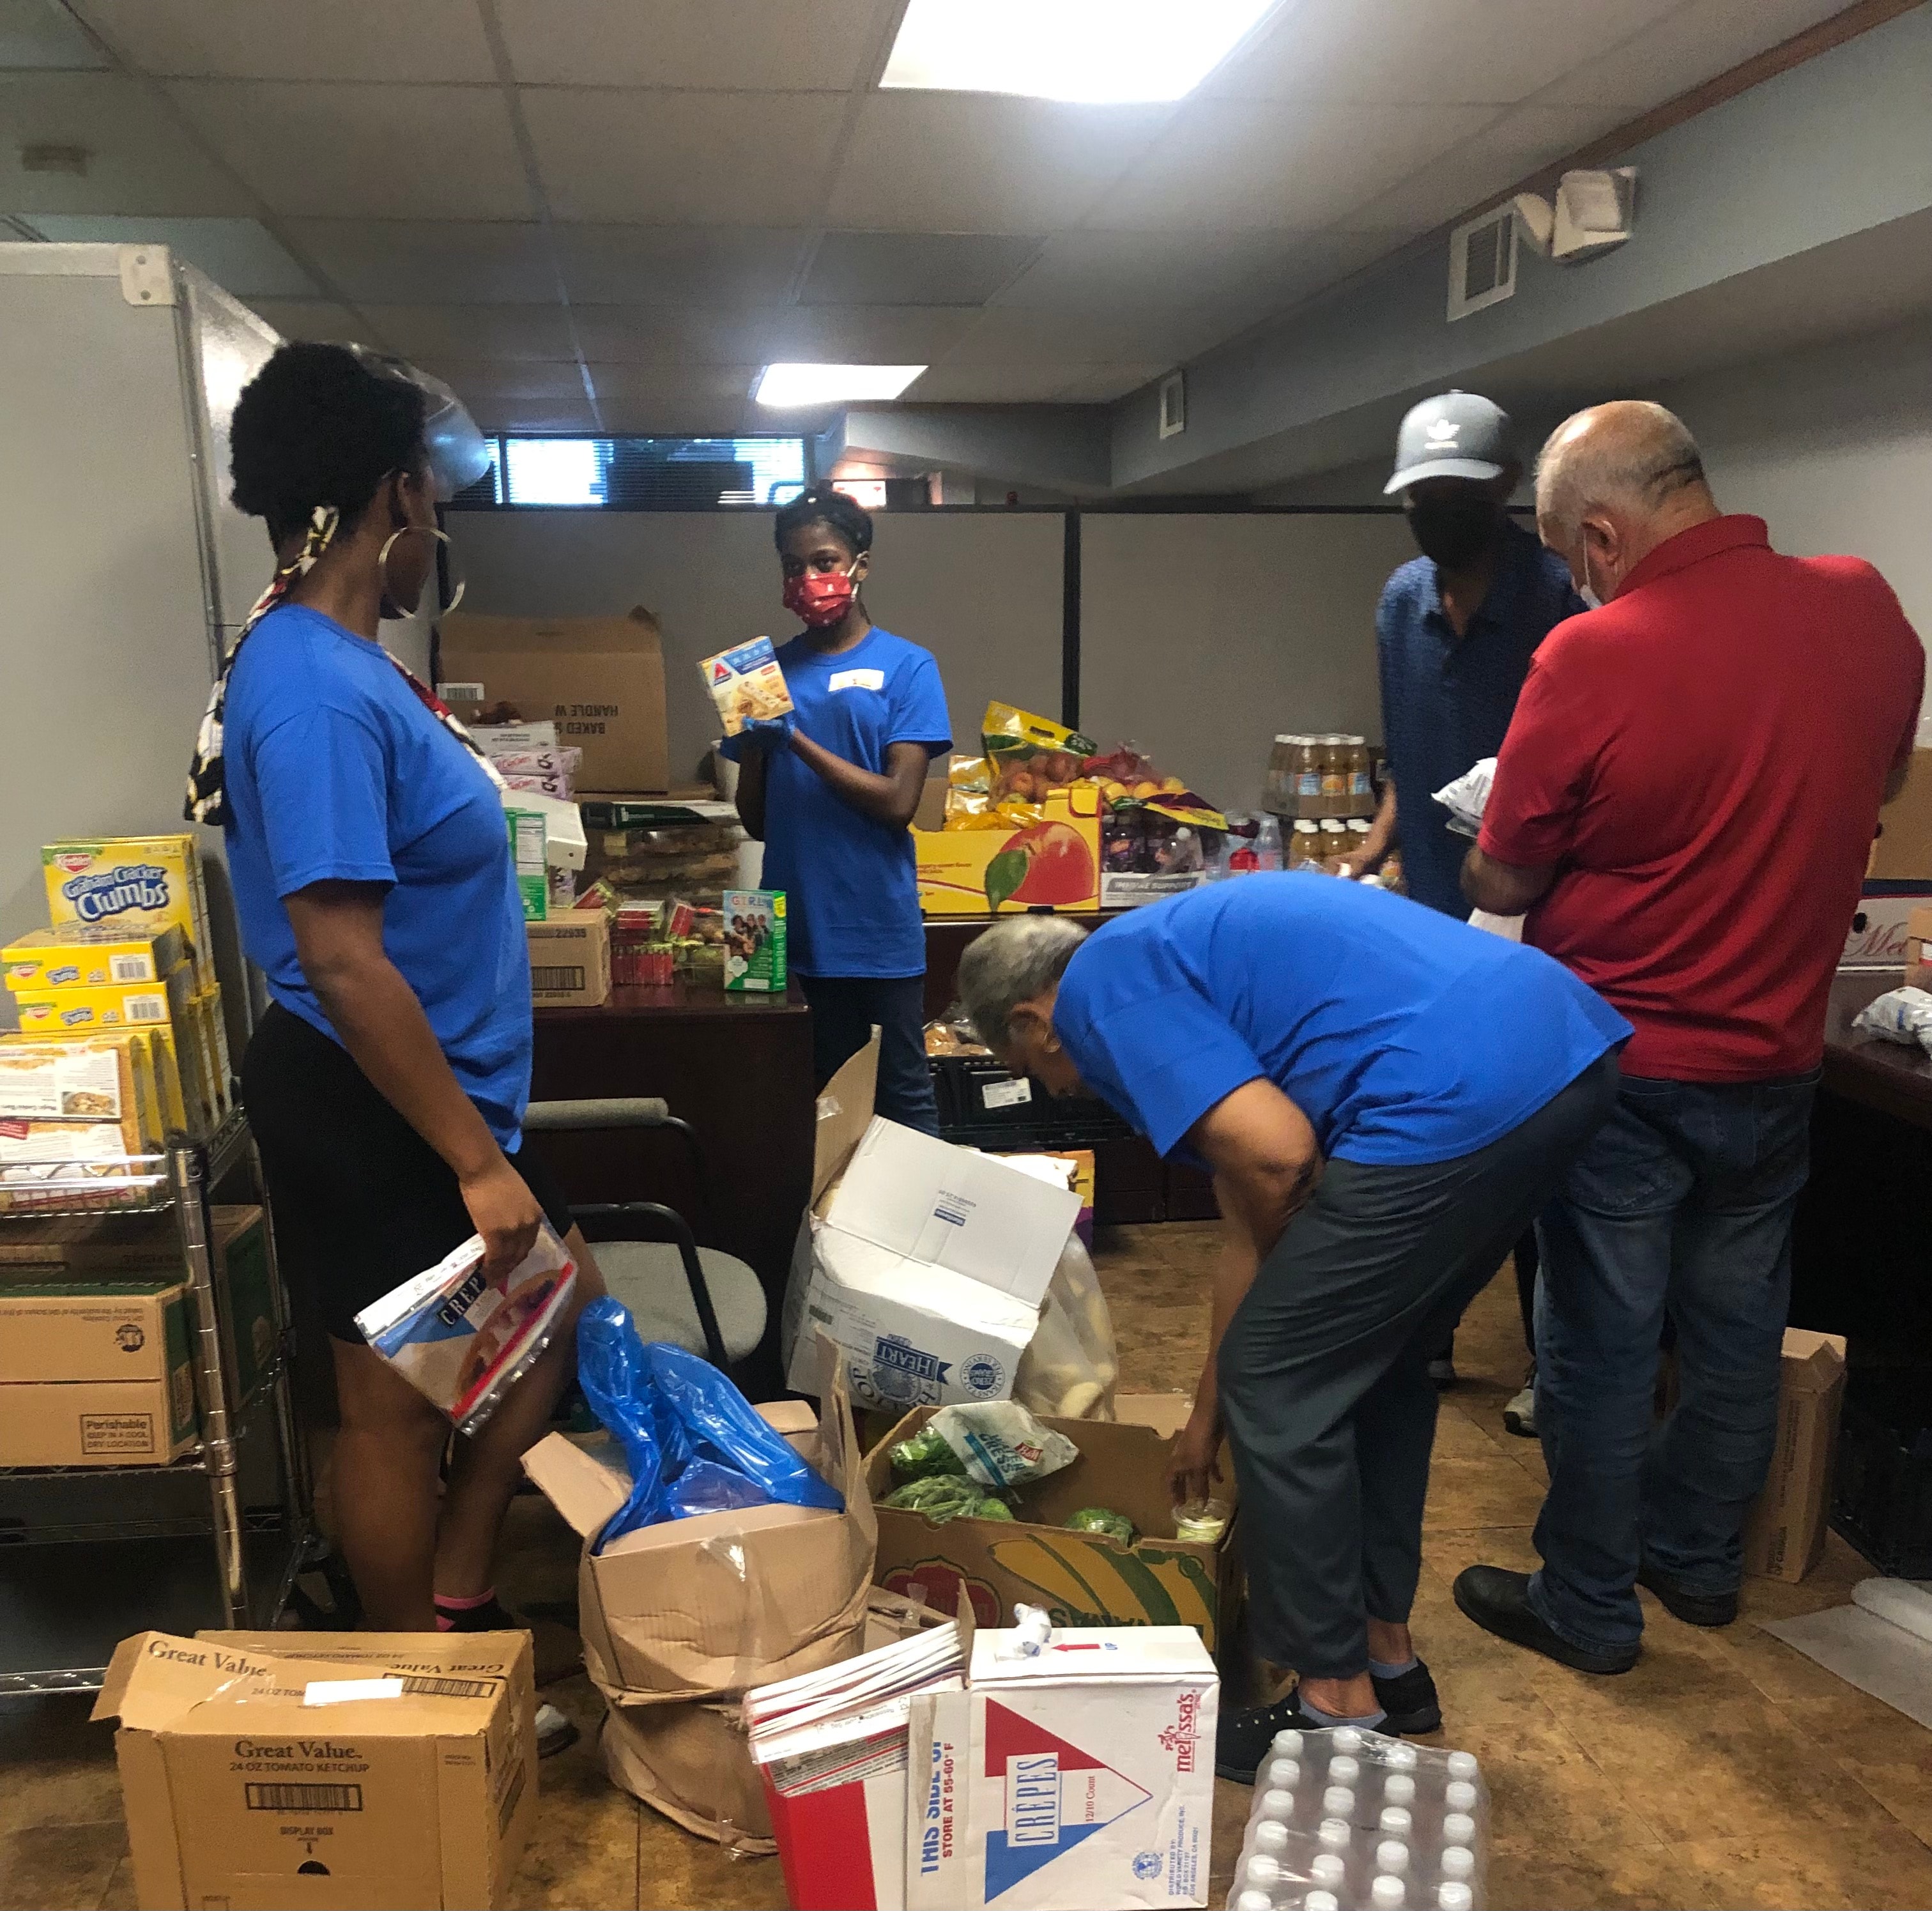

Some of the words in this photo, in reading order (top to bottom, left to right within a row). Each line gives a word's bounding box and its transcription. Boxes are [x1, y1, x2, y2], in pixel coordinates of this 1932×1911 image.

[567, 722, 606, 734] BAKED
[76, 880, 169, 920] Crumbs
[86, 1419, 146, 1429] Perishable
[147, 1640, 207, 1666] Great
[1104, 1642, 1118, 1650] UP
[448, 1664, 505, 1673] Great
[281, 1688, 306, 1697] TOM
[234, 1740, 294, 1758] Great
[944, 1742, 954, 1751] F
[229, 1762, 243, 1772] 24
[245, 1762, 263, 1772] OZ
[265, 1762, 314, 1772] TOMATO
[317, 1763, 370, 1773] KETCHUP
[1086, 1776, 1096, 1799] Count
[942, 1797, 954, 1813] AT
[1085, 1800, 1094, 1822] 12/10
[942, 1816, 953, 1858] STORE
[921, 1826, 940, 1876] THIS
